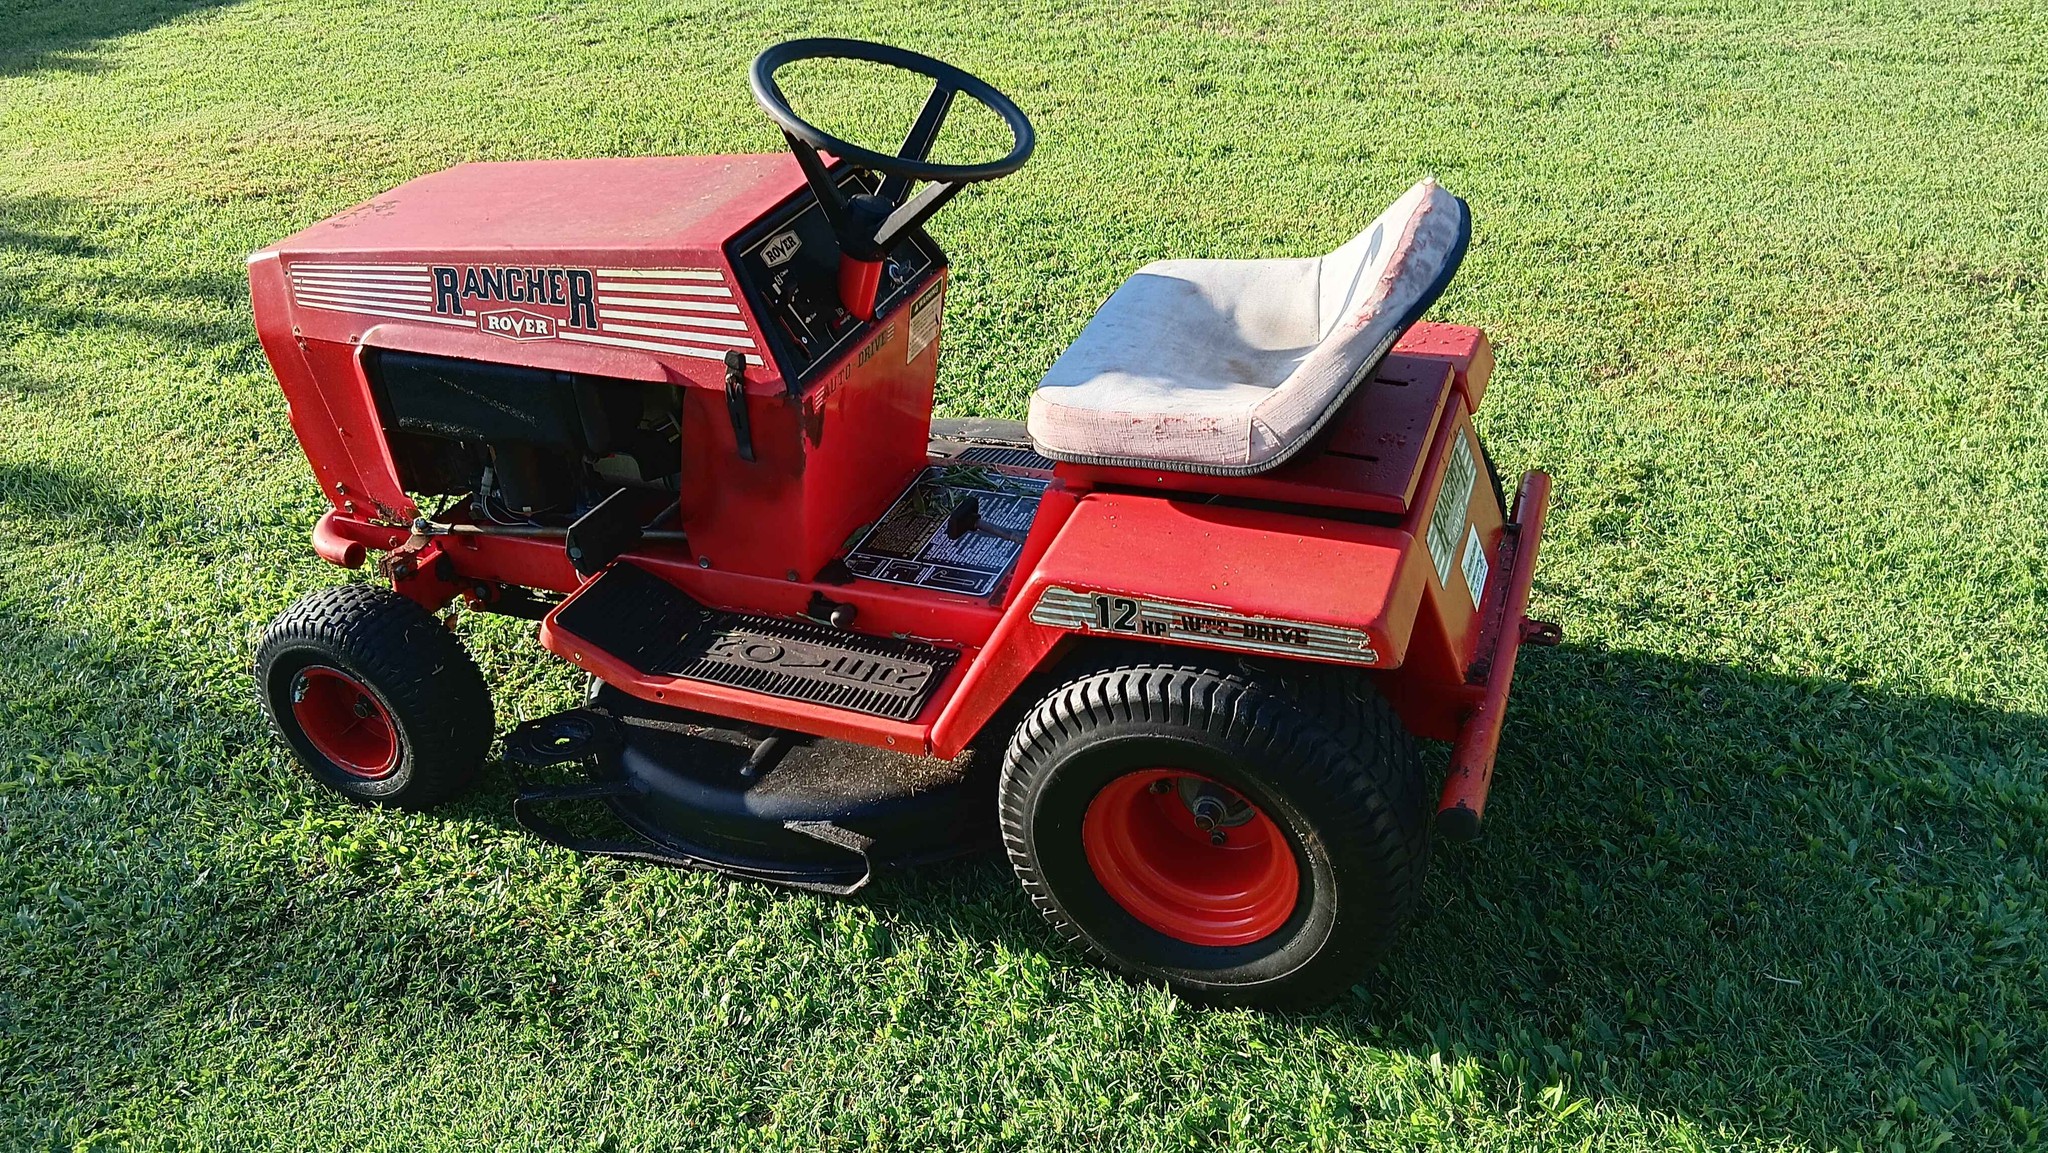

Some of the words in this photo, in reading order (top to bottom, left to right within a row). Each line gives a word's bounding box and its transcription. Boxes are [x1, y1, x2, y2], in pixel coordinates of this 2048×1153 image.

[765, 235, 797, 263] ROVER
[432, 266, 599, 330] RANCHER
[487, 314, 549, 337] ROVER
[857, 329, 887, 368] DRIVE
[1433, 447, 1468, 554] RANCHER
[1095, 596, 1138, 632] 12
[1141, 620, 1168, 637] HP
